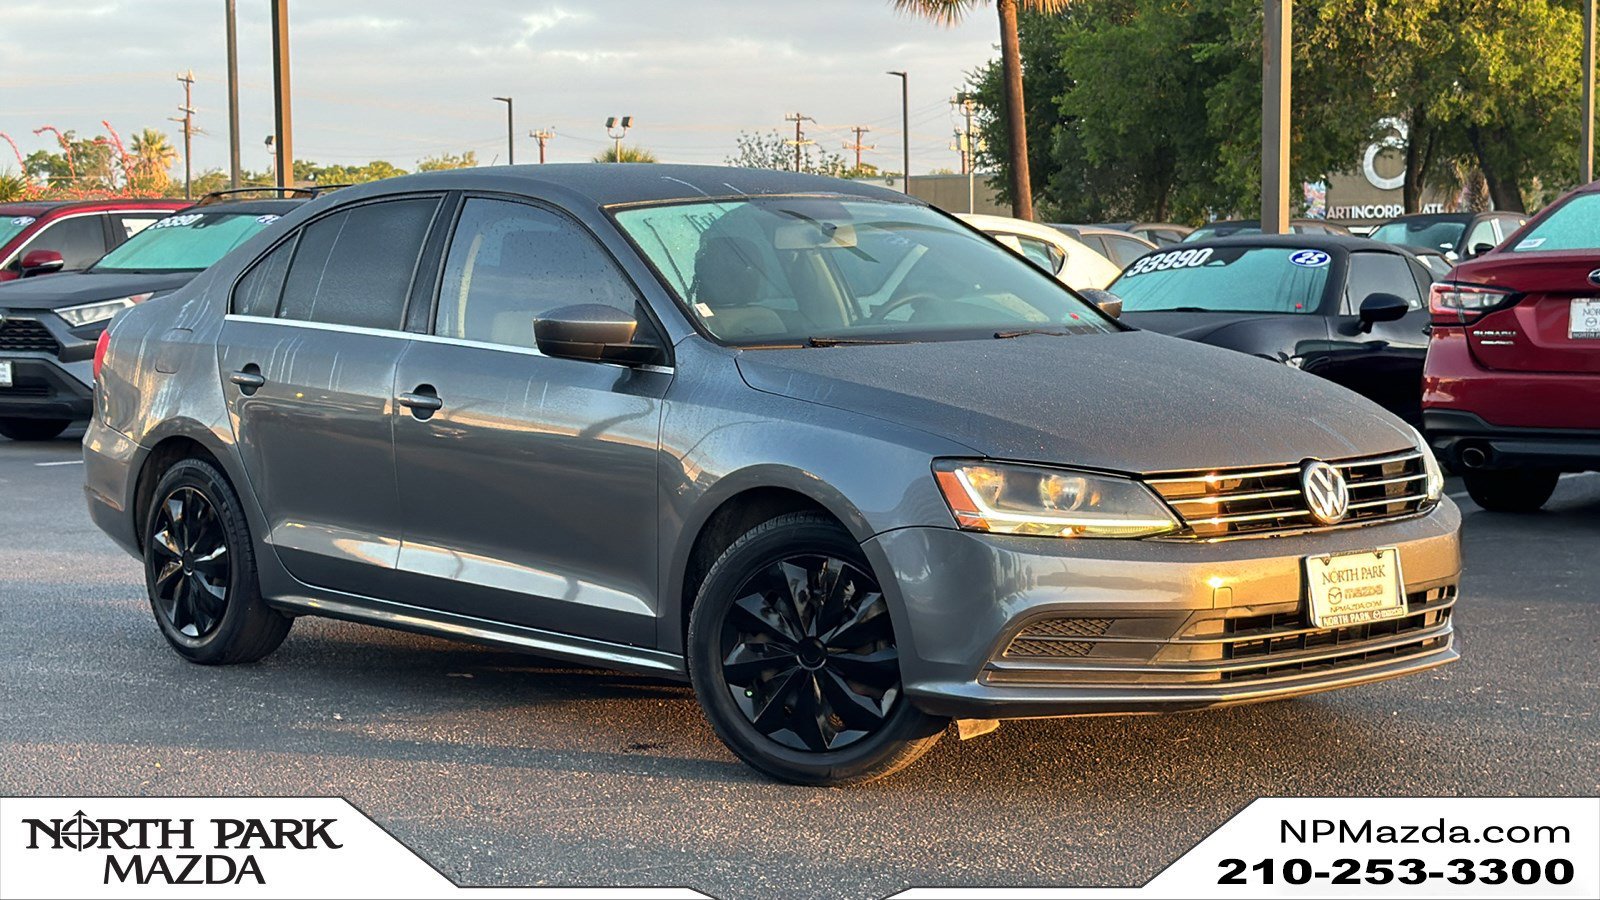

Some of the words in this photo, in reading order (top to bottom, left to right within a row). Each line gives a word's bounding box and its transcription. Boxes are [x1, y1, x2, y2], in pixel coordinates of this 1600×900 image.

[1126, 247, 1214, 278] 33990
[1295, 252, 1325, 264] 25
[1322, 567, 1359, 585] NORTH
[1361, 564, 1386, 580] PARK
[1323, 613, 1349, 627] NORTH
[1350, 610, 1371, 623] PARK
